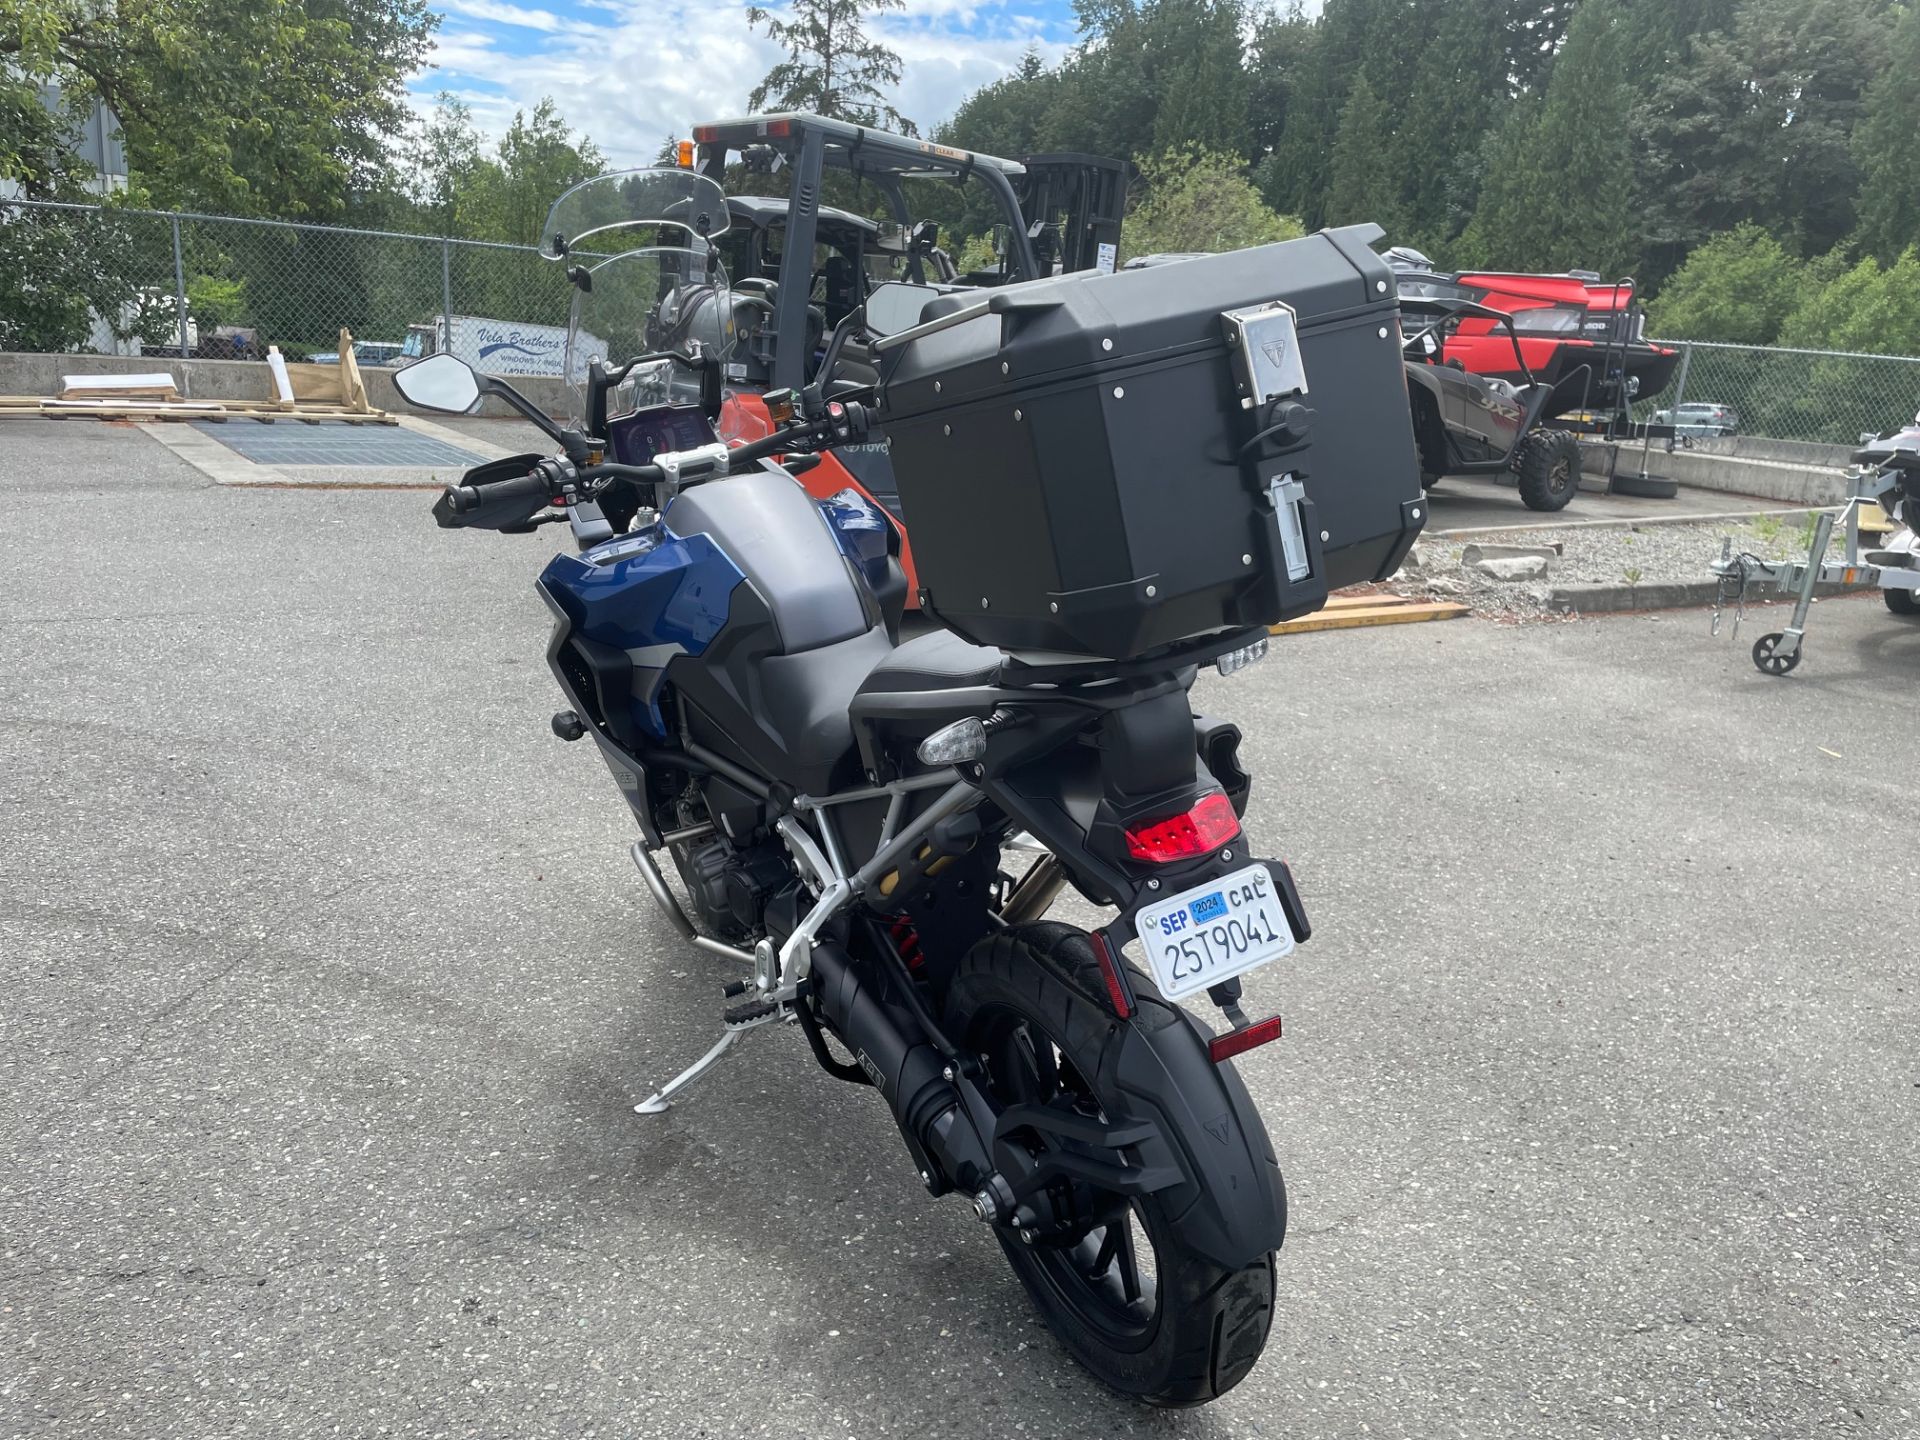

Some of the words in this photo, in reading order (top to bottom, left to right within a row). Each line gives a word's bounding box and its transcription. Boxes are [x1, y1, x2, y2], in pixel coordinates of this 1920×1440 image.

[477, 328, 504, 343] Vela
[509, 331, 560, 349] Brothers
[862, 443, 889, 454] TOYO
[1159, 909, 1188, 936] SEP
[1195, 896, 1219, 914] 2024
[1229, 882, 1267, 907] CAL
[1165, 908, 1279, 980] 25T9041
